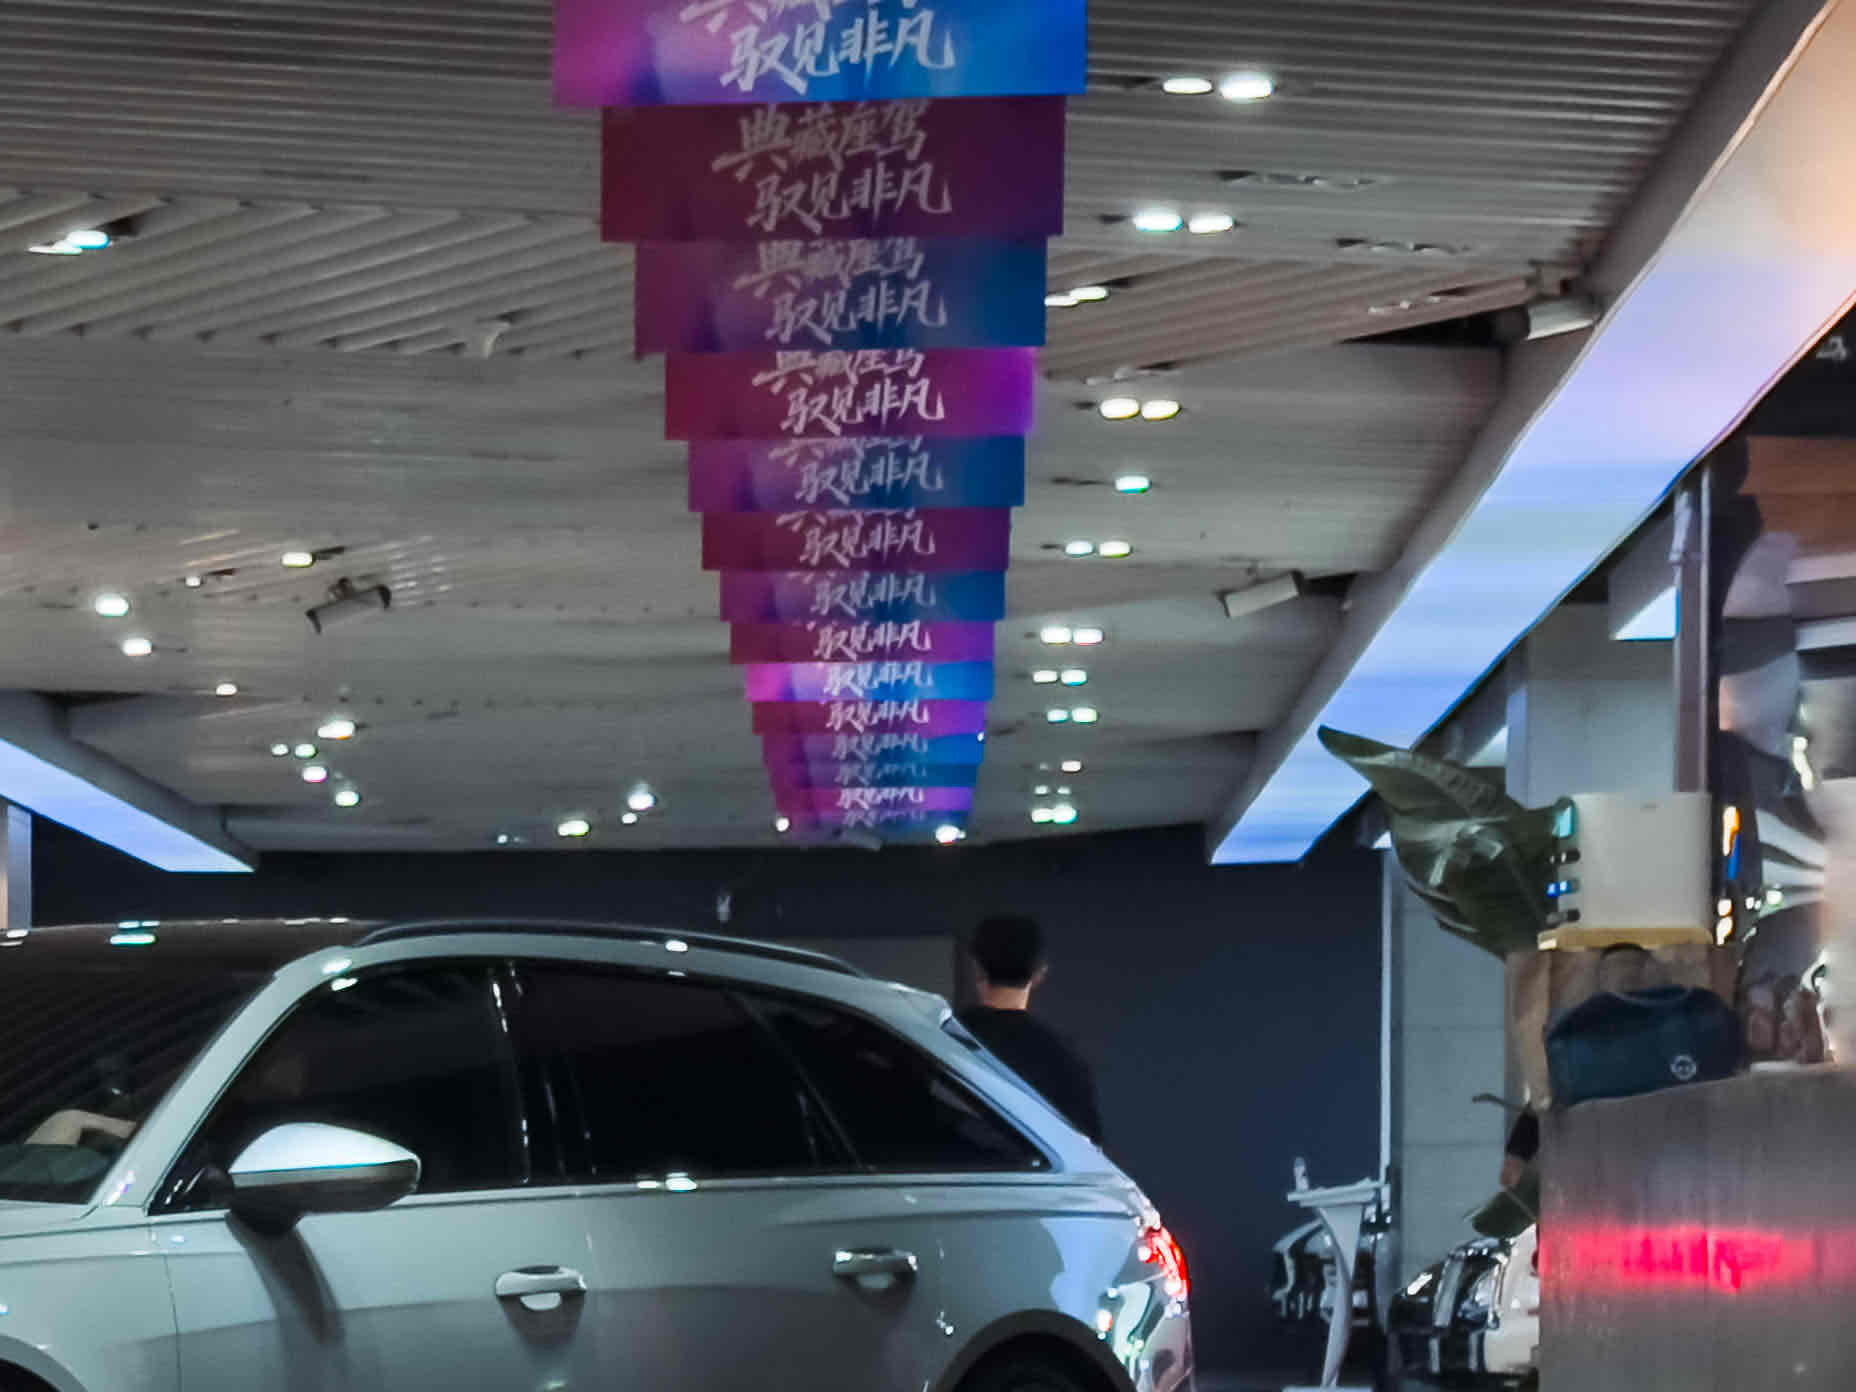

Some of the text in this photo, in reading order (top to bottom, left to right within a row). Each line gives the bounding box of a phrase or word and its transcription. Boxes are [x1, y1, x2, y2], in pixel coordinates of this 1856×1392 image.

[720, 10, 956, 95] 驭见非凡
[711, 98, 927, 182] 典藏座驾
[746, 161, 952, 235] 驭见非凡
[764, 280, 948, 345] 驭见非凡
[780, 377, 944, 436] 驭见非凡
